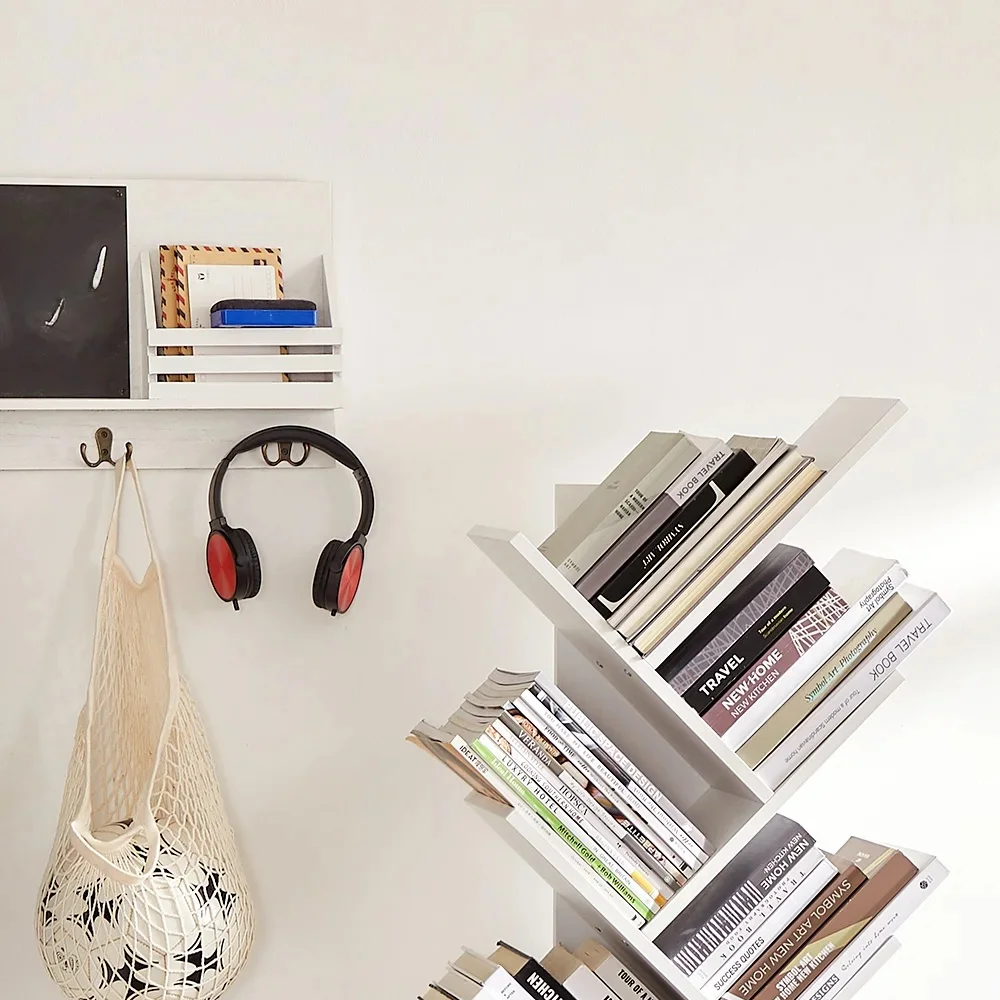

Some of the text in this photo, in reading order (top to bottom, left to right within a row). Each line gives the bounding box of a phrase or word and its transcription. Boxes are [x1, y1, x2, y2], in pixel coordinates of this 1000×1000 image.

[678, 452, 724, 498] TRAVEL BOOK
[658, 524, 683, 551] SYMBOL
[858, 575, 891, 608] Photography
[864, 582, 893, 612] Symbol Art
[803, 627, 878, 702] Symbol Art Photography
[868, 617, 931, 680] TRAVEL BOOK
[699, 651, 743, 696] TRAVEL
[721, 648, 782, 709] NEW HOME
[731, 669, 779, 717] NEW KITCHEN
[516, 730, 552, 765] VERANDA
[784, 687, 859, 763] Tour modern Scandinavian home
[561, 701, 599, 738] PUBLIC
[595, 735, 629, 768] SPACE
[625, 765, 662, 801] DESIGN
[561, 744, 575, 758] TIME
[489, 757, 508, 776] Ideal
[506, 774, 527, 794] Home
[520, 761, 541, 782] COOKING
[541, 782, 569, 809] SOUTHERN
[567, 808, 584, 824] HOME
[596, 765, 625, 793] BEAUTIFUL
[533, 788, 559, 813] HOTEL
[558, 785, 589, 815] HOPSCA
[556, 825, 582, 850] Mitchell
[579, 846, 596, 863] Gold
[610, 877, 636, 903] Williams
[762, 840, 808, 889] NEW HOME
[765, 833, 802, 872] NEW KITCHEN
[721, 872, 804, 959] TRAVEL BOOK
[739, 880, 851, 995] SYMBOL ART NEW HOME
[617, 969, 635, 987] TOUR
[631, 983, 643, 995] OF
[639, 991, 649, 1000] A
[715, 937, 764, 989] SUCCESS QUOTES
[775, 951, 814, 991] SYMBOL ART
[780, 979, 799, 998] HOME
[796, 965, 812, 982] NEW
[809, 942, 835, 969] KITCHEN
